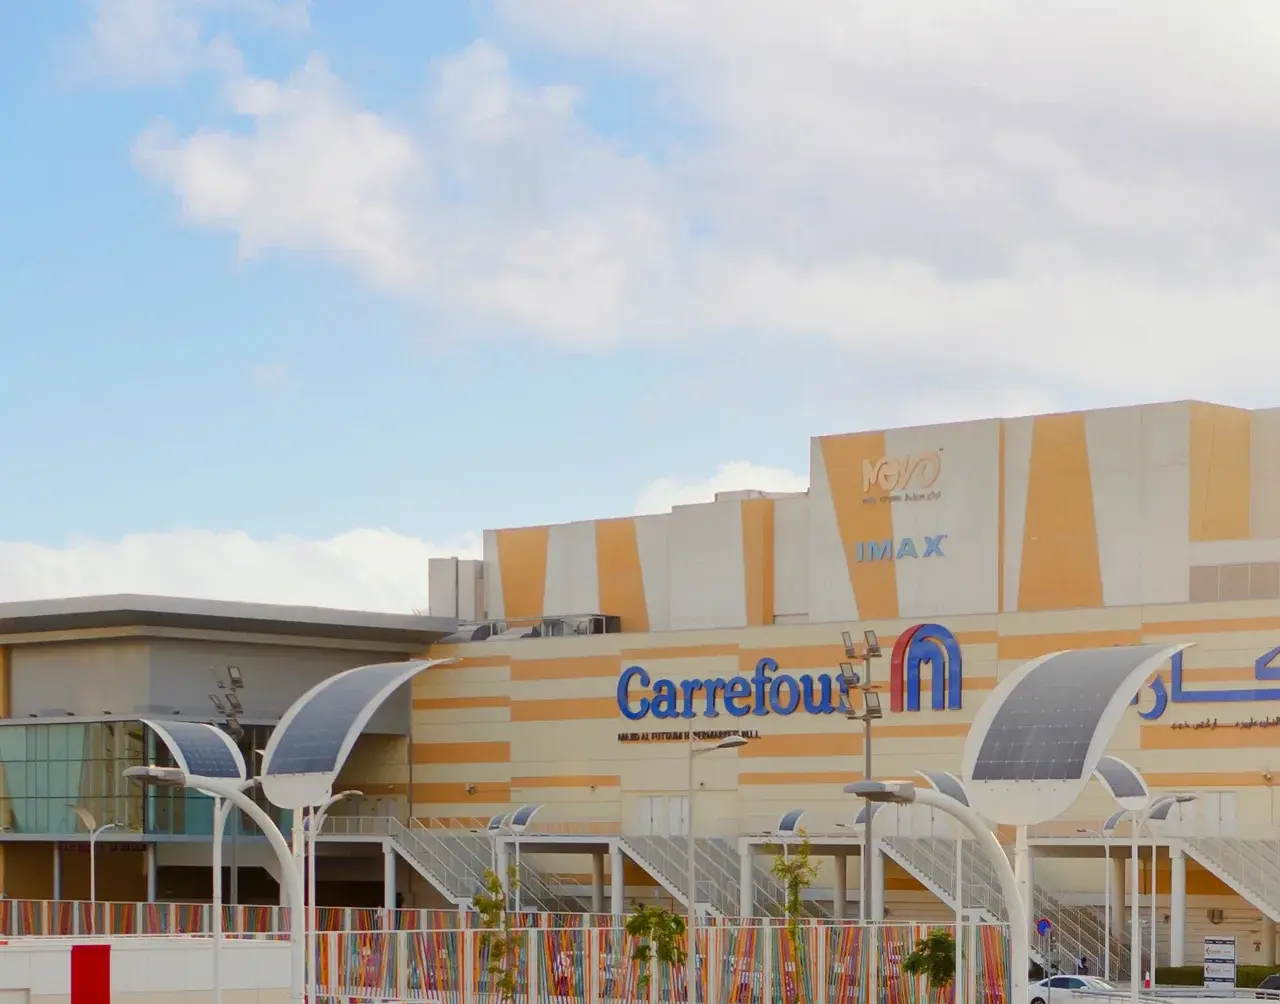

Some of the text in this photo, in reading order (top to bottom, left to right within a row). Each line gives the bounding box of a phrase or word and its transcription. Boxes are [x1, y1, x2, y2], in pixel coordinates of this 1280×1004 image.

[862, 450, 942, 493] NOVO
[856, 535, 946, 563] IMAX
[616, 657, 860, 721] Carrefour
